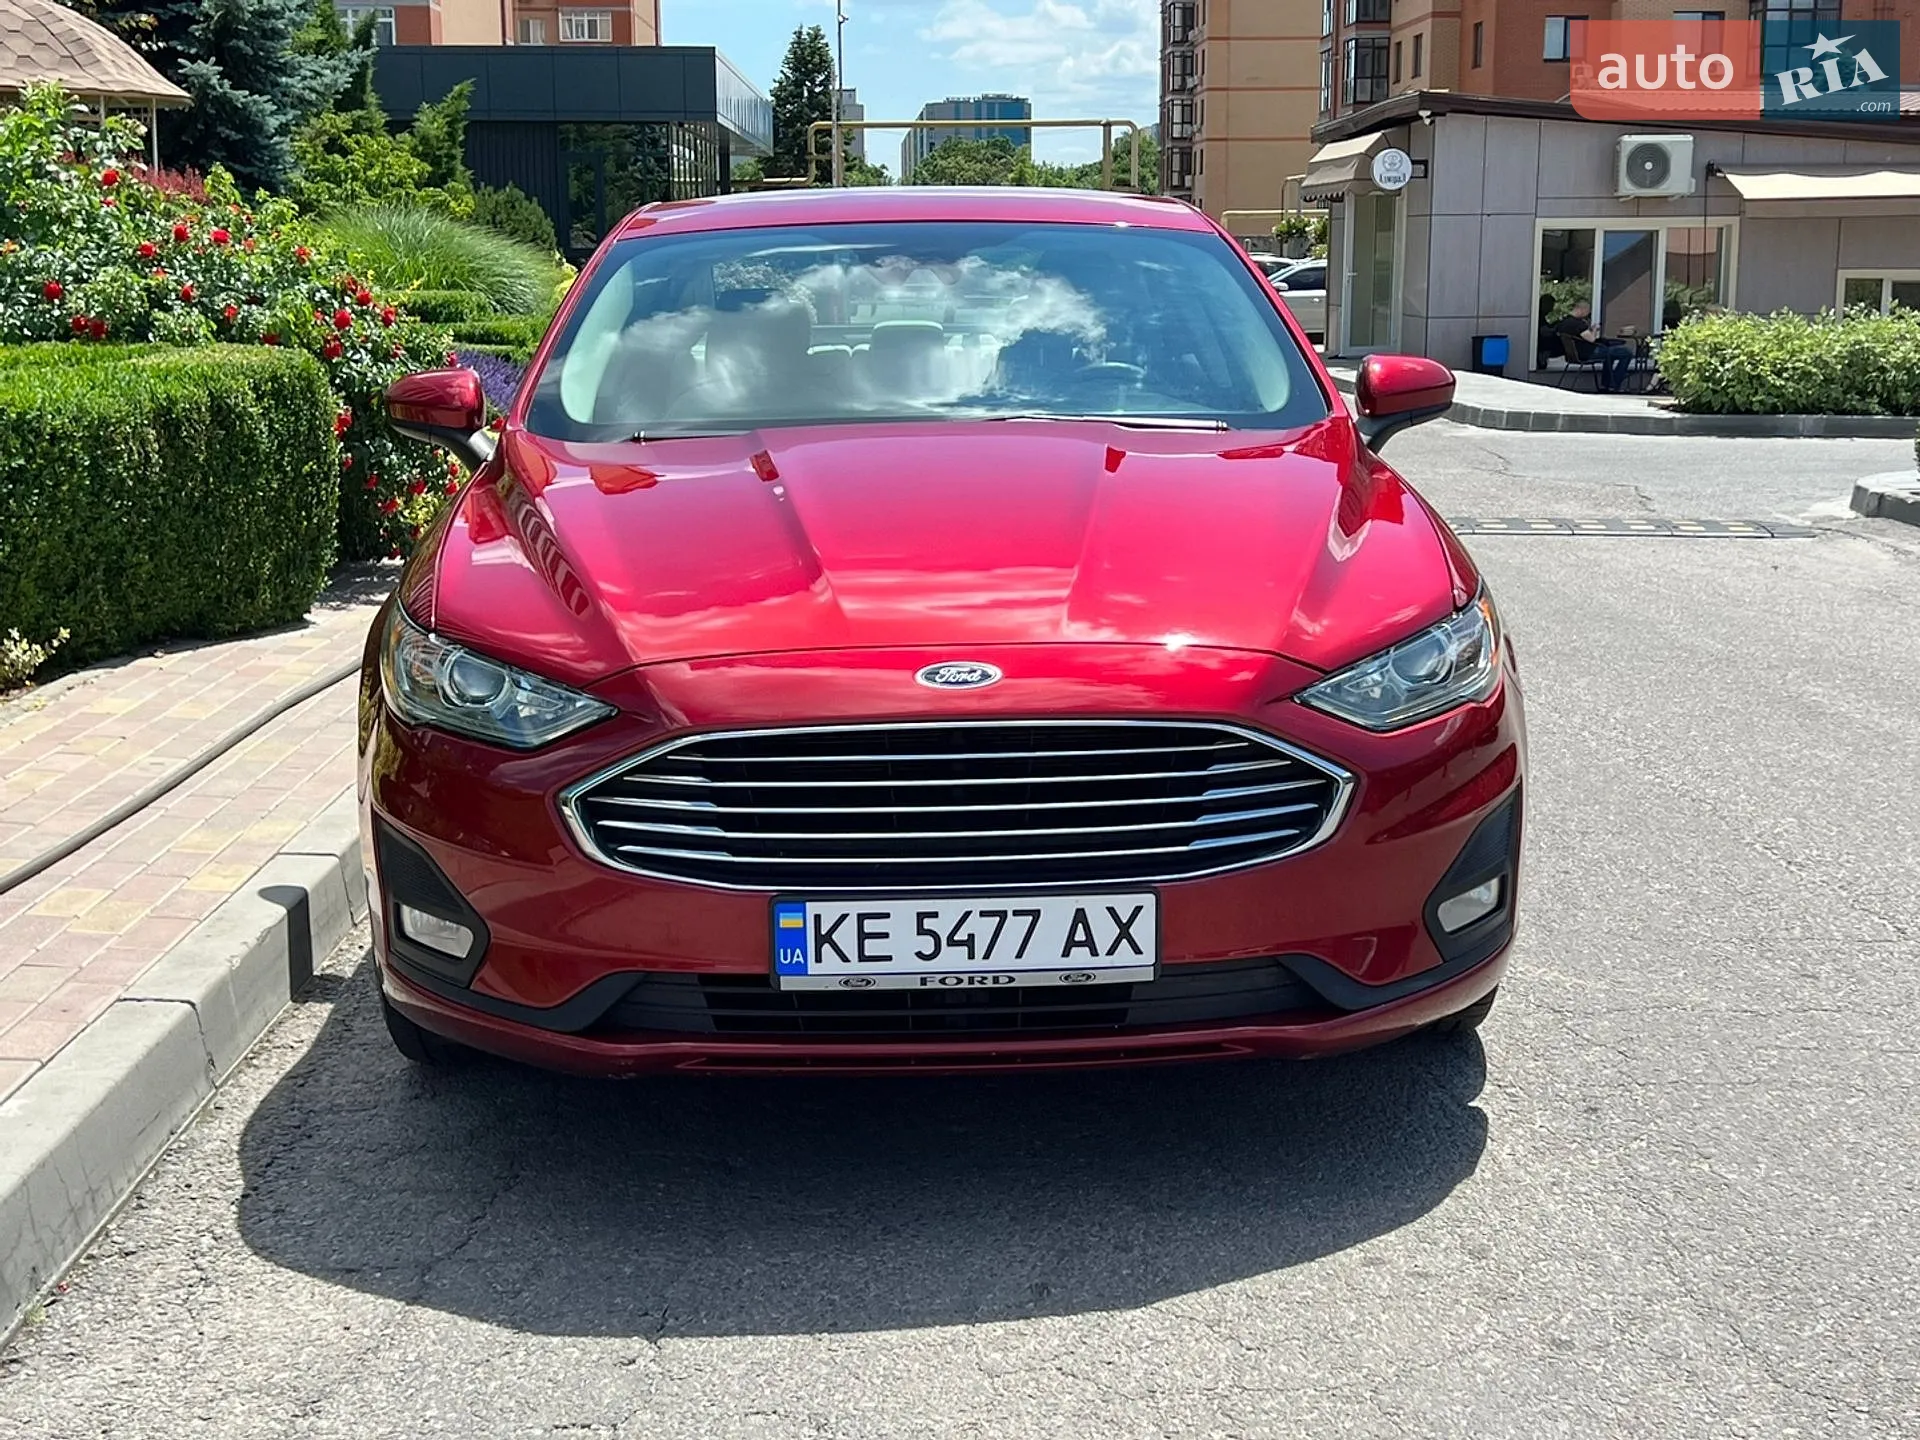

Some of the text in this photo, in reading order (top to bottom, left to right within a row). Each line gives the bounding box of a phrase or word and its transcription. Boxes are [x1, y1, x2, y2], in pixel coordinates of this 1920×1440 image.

[935, 666, 982, 683] Ford
[813, 905, 1144, 964] KE 5477 AX
[780, 949, 804, 964] UA
[919, 975, 1016, 987] FORD
